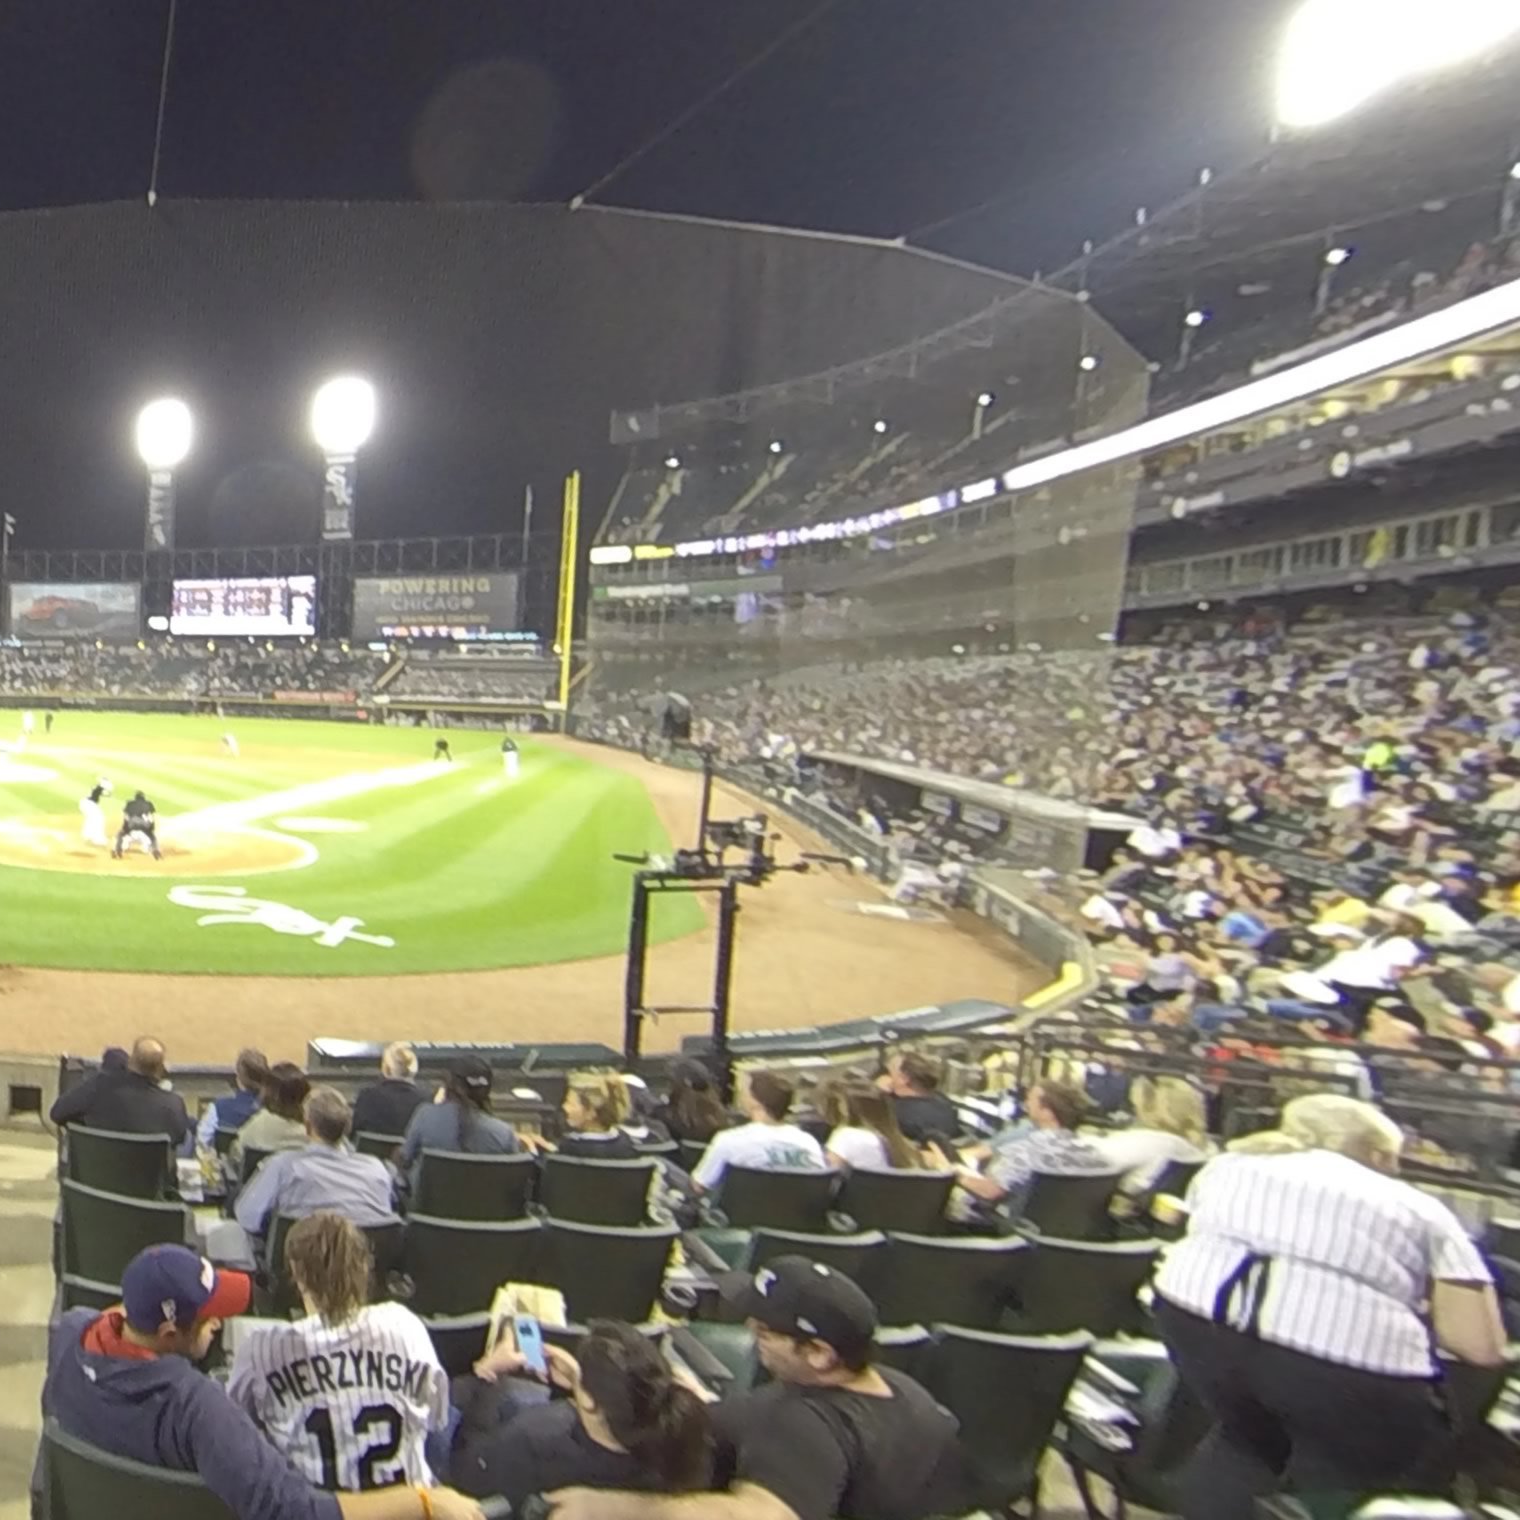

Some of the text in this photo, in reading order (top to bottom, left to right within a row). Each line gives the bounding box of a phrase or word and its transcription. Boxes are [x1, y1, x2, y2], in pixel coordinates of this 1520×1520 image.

[379, 577, 492, 595] POWERING
[265, 1349, 432, 1408] PIERZYNSKI
[304, 1402, 408, 1493] 12
